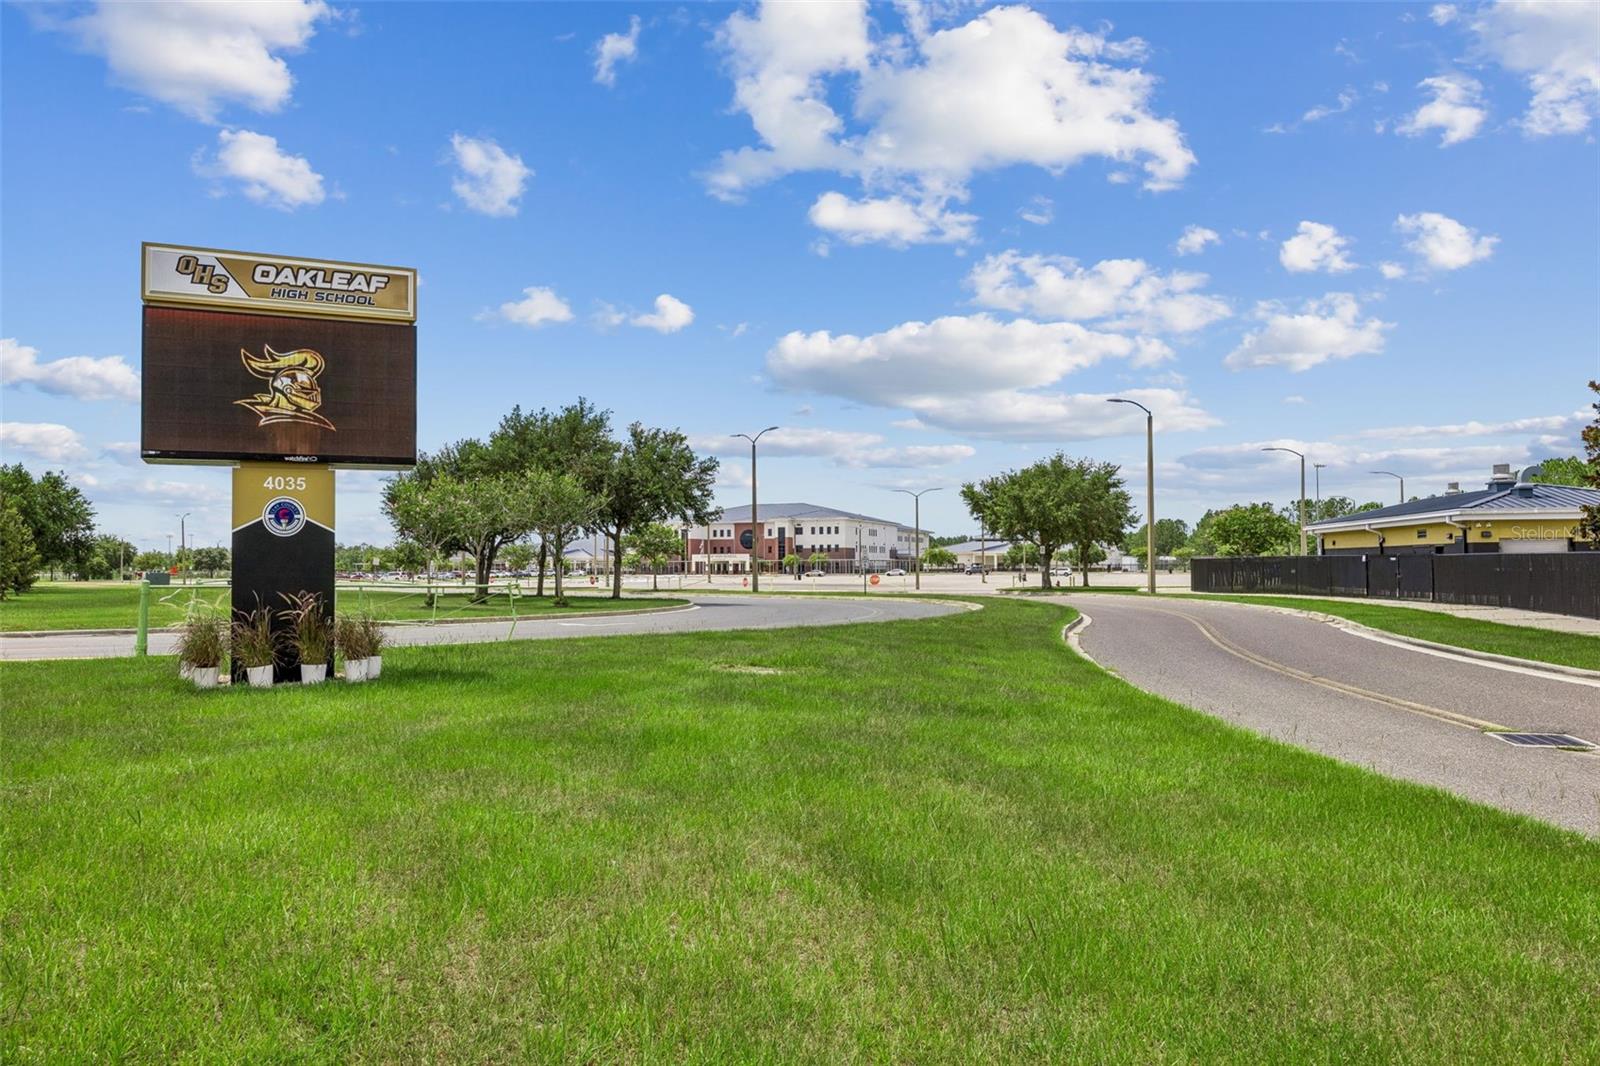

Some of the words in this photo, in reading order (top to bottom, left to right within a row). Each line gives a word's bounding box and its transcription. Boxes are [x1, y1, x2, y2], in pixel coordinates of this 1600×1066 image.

[176, 255, 229, 294] OHS
[252, 264, 390, 293] OAKLEAF
[271, 287, 308, 300] HIGH
[314, 292, 376, 306] SCHOOL
[263, 476, 307, 491] 4035
